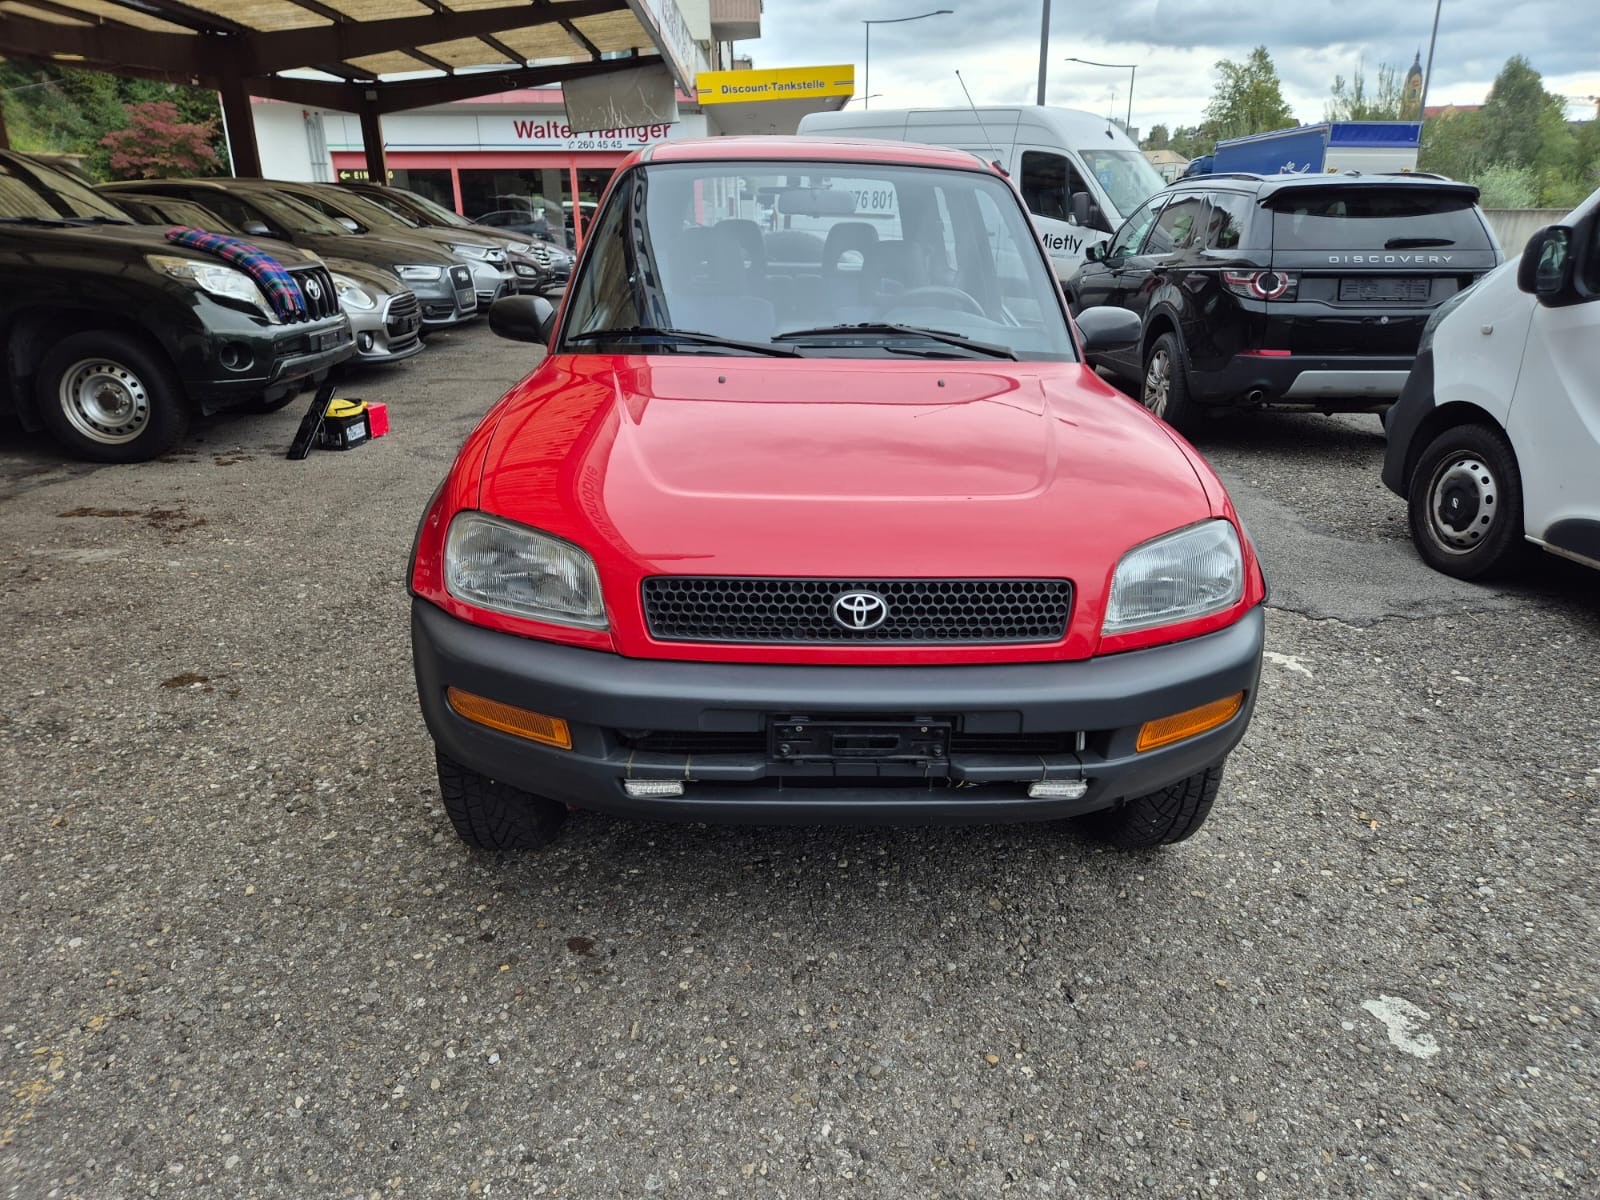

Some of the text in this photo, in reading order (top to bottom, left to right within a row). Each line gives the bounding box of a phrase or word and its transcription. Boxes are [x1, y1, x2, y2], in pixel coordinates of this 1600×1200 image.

[721, 80, 825, 94] Discount-Tankstelle
[513, 120, 578, 138] Walte
[577, 140, 623, 149] 260 45 45
[353, 170, 394, 180] EING
[850, 190, 894, 209] 76 801
[1328, 255, 1453, 264] DISCOVERY
